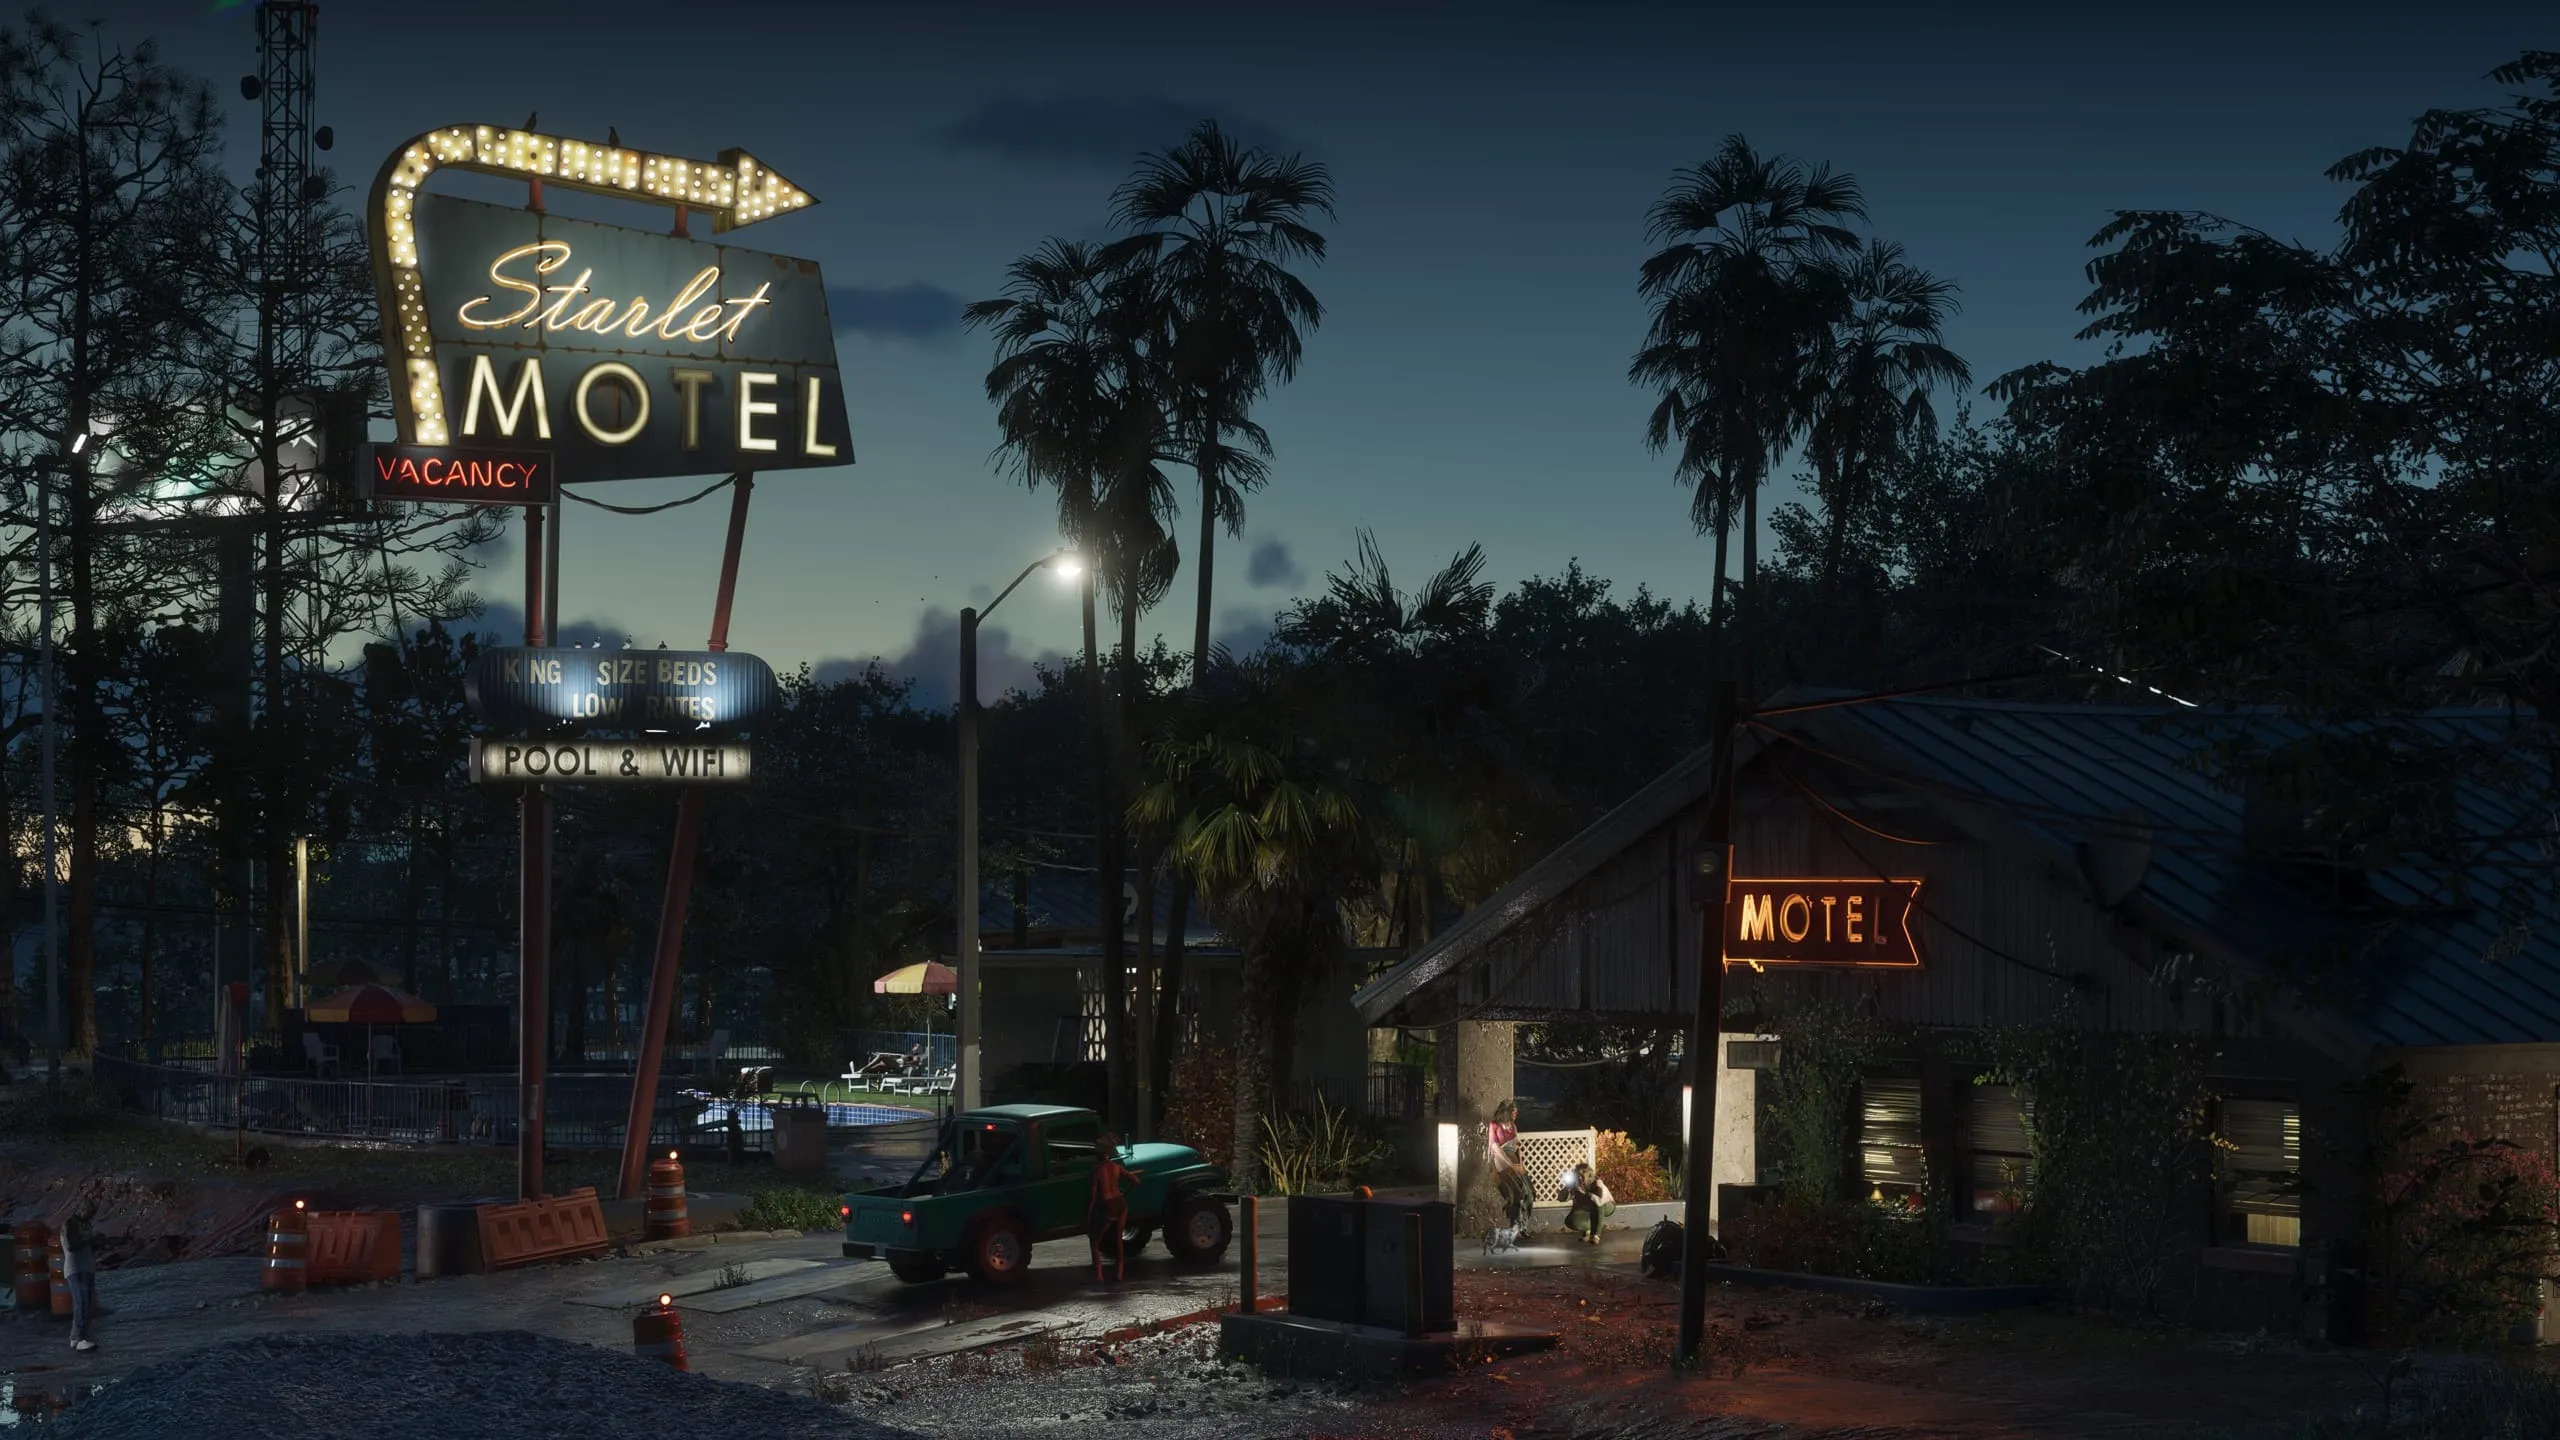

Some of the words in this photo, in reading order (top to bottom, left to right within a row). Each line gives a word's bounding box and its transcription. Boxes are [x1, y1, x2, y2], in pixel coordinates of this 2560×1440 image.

[458, 239, 772, 343] Starlet
[457, 354, 838, 458] MOTEL
[376, 455, 537, 489] VACANCY
[504, 657, 562, 685] KNG
[596, 659, 647, 686] SIZE
[657, 659, 718, 686] BEDS
[572, 692, 624, 721] LOW
[645, 696, 716, 722] RATES
[504, 746, 597, 777] POOL
[619, 749, 640, 777] &
[661, 748, 725, 778] WIFI
[1739, 893, 1888, 945] MOTEL
